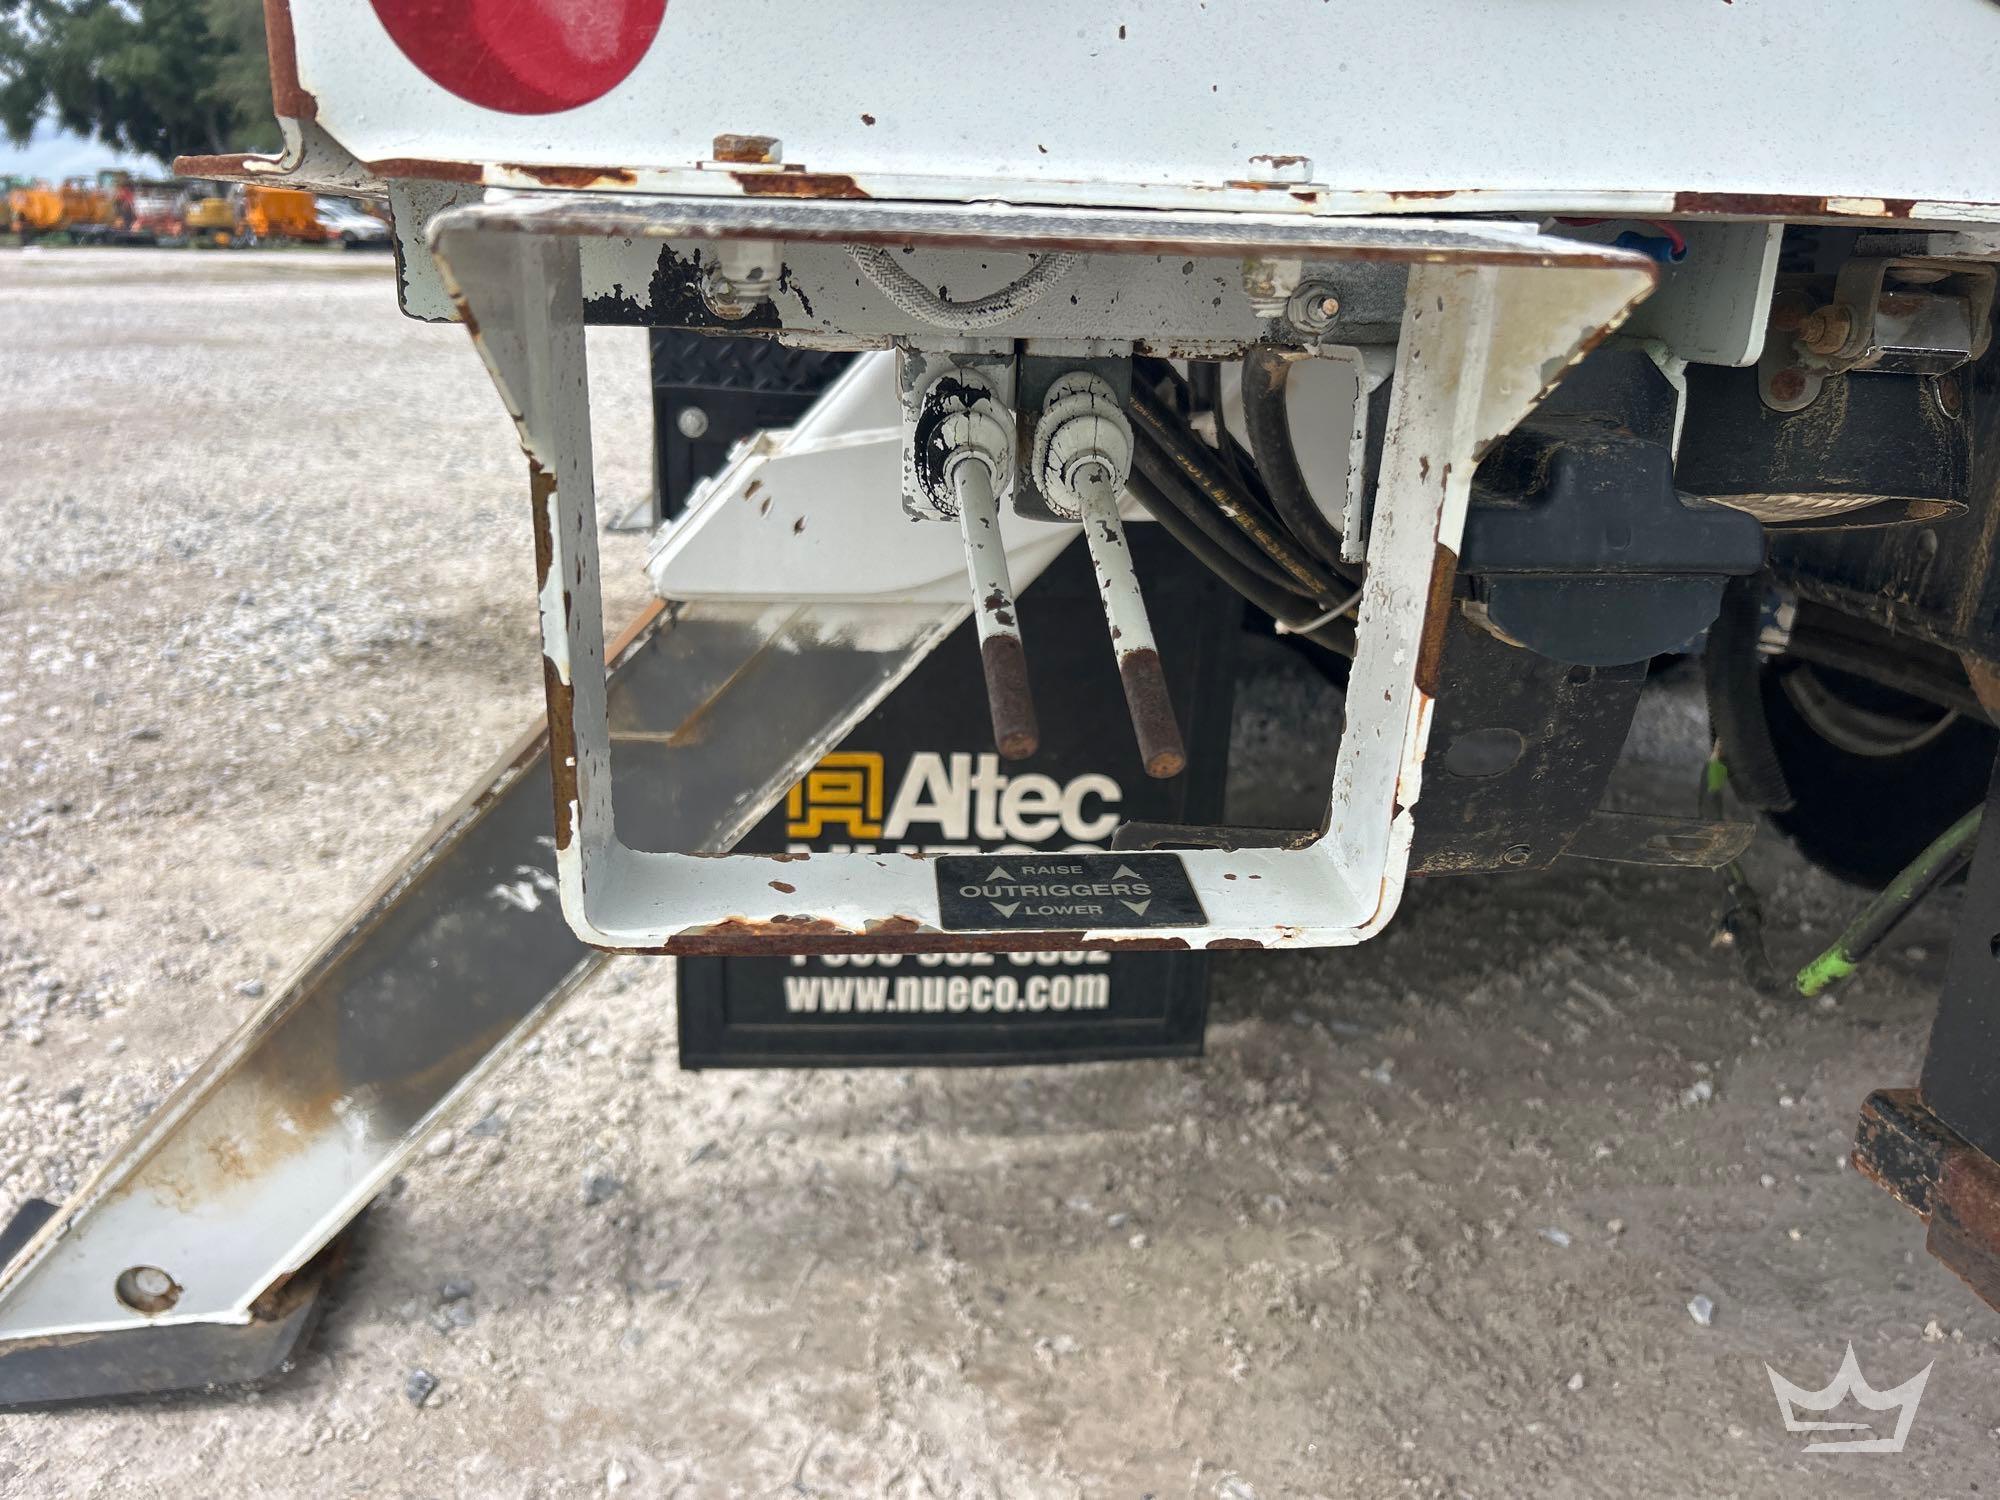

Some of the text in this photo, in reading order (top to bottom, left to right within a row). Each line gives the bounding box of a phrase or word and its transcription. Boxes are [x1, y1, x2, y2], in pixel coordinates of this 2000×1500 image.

[883, 751, 1123, 842] Altec
[1021, 865, 1084, 875] RAISE
[959, 883, 1152, 898] OUTRIGGERS
[1025, 905, 1104, 916] LOWER
[784, 973, 1111, 1014] www.nueco.com
